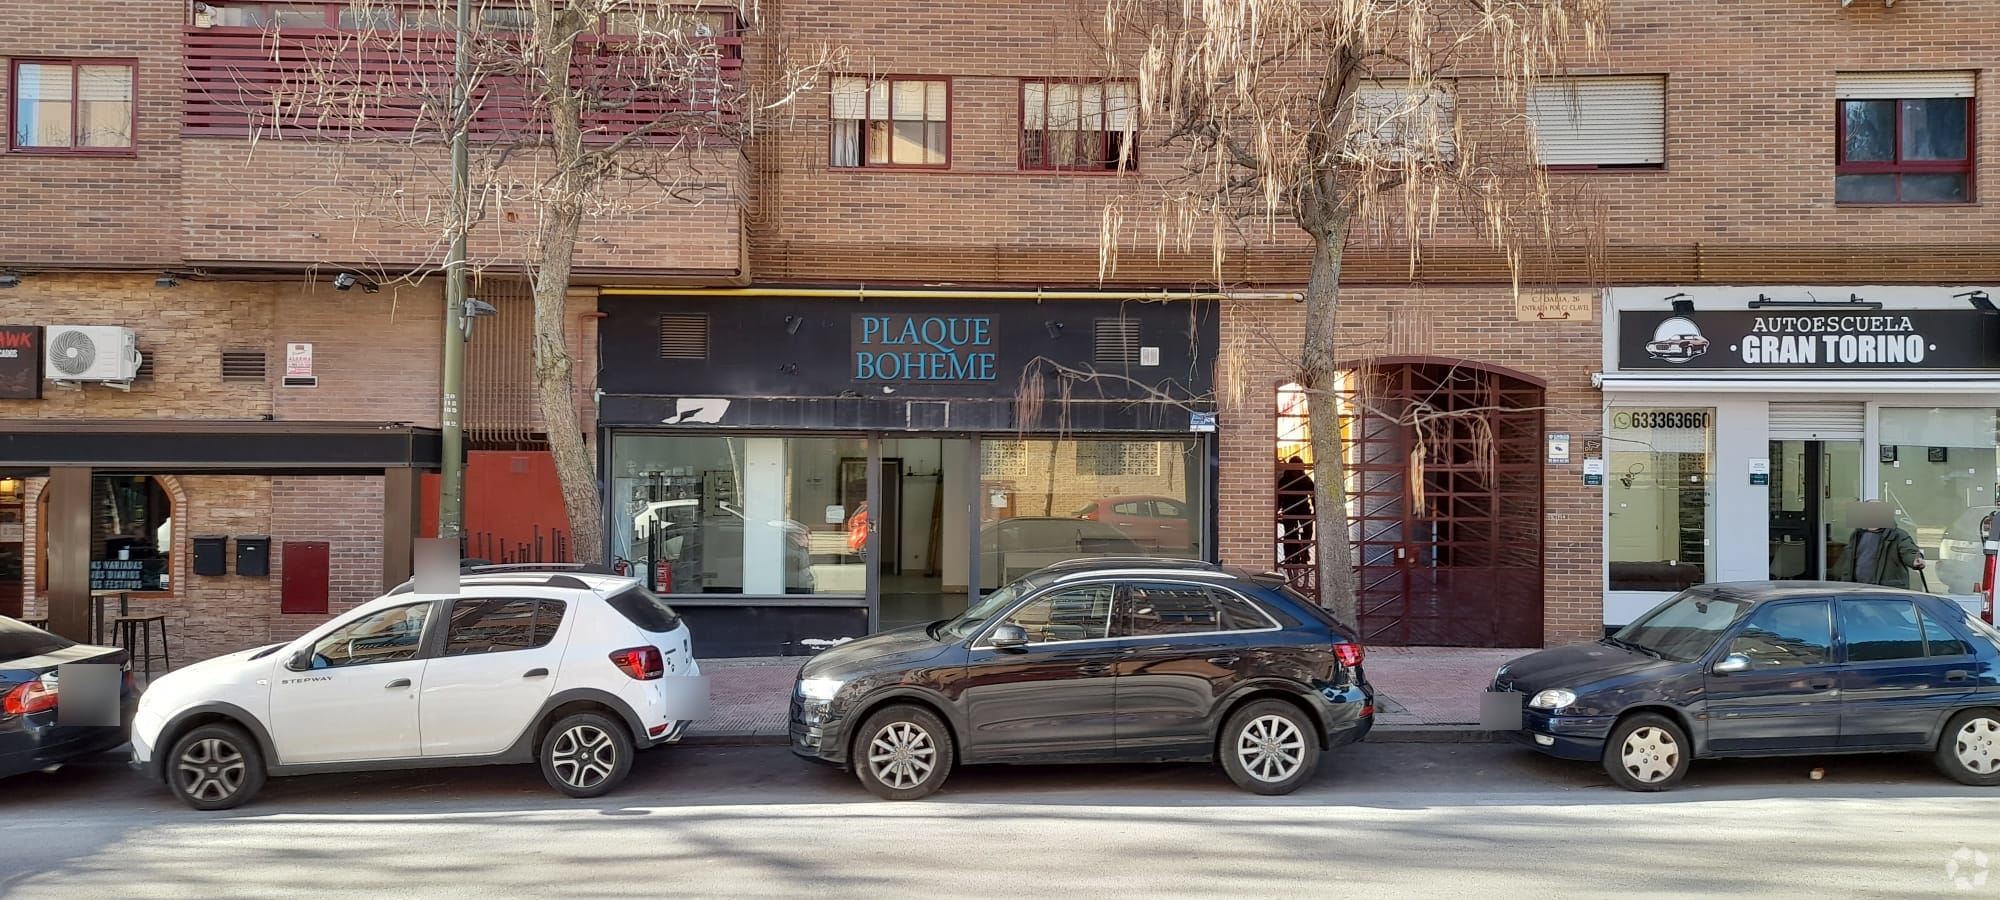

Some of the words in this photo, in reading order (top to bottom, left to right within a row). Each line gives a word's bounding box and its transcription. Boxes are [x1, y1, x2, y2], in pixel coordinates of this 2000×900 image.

[862, 316, 992, 353] PLAQUE
[1752, 316, 1914, 333] AUTOESCUELA
[1742, 335, 1816, 364] GRAN
[1822, 334, 1924, 363] TORINO
[855, 352, 996, 381] BOHEME
[1631, 411, 1710, 429] 633363660
[281, 675, 333, 684] STEPWAY
